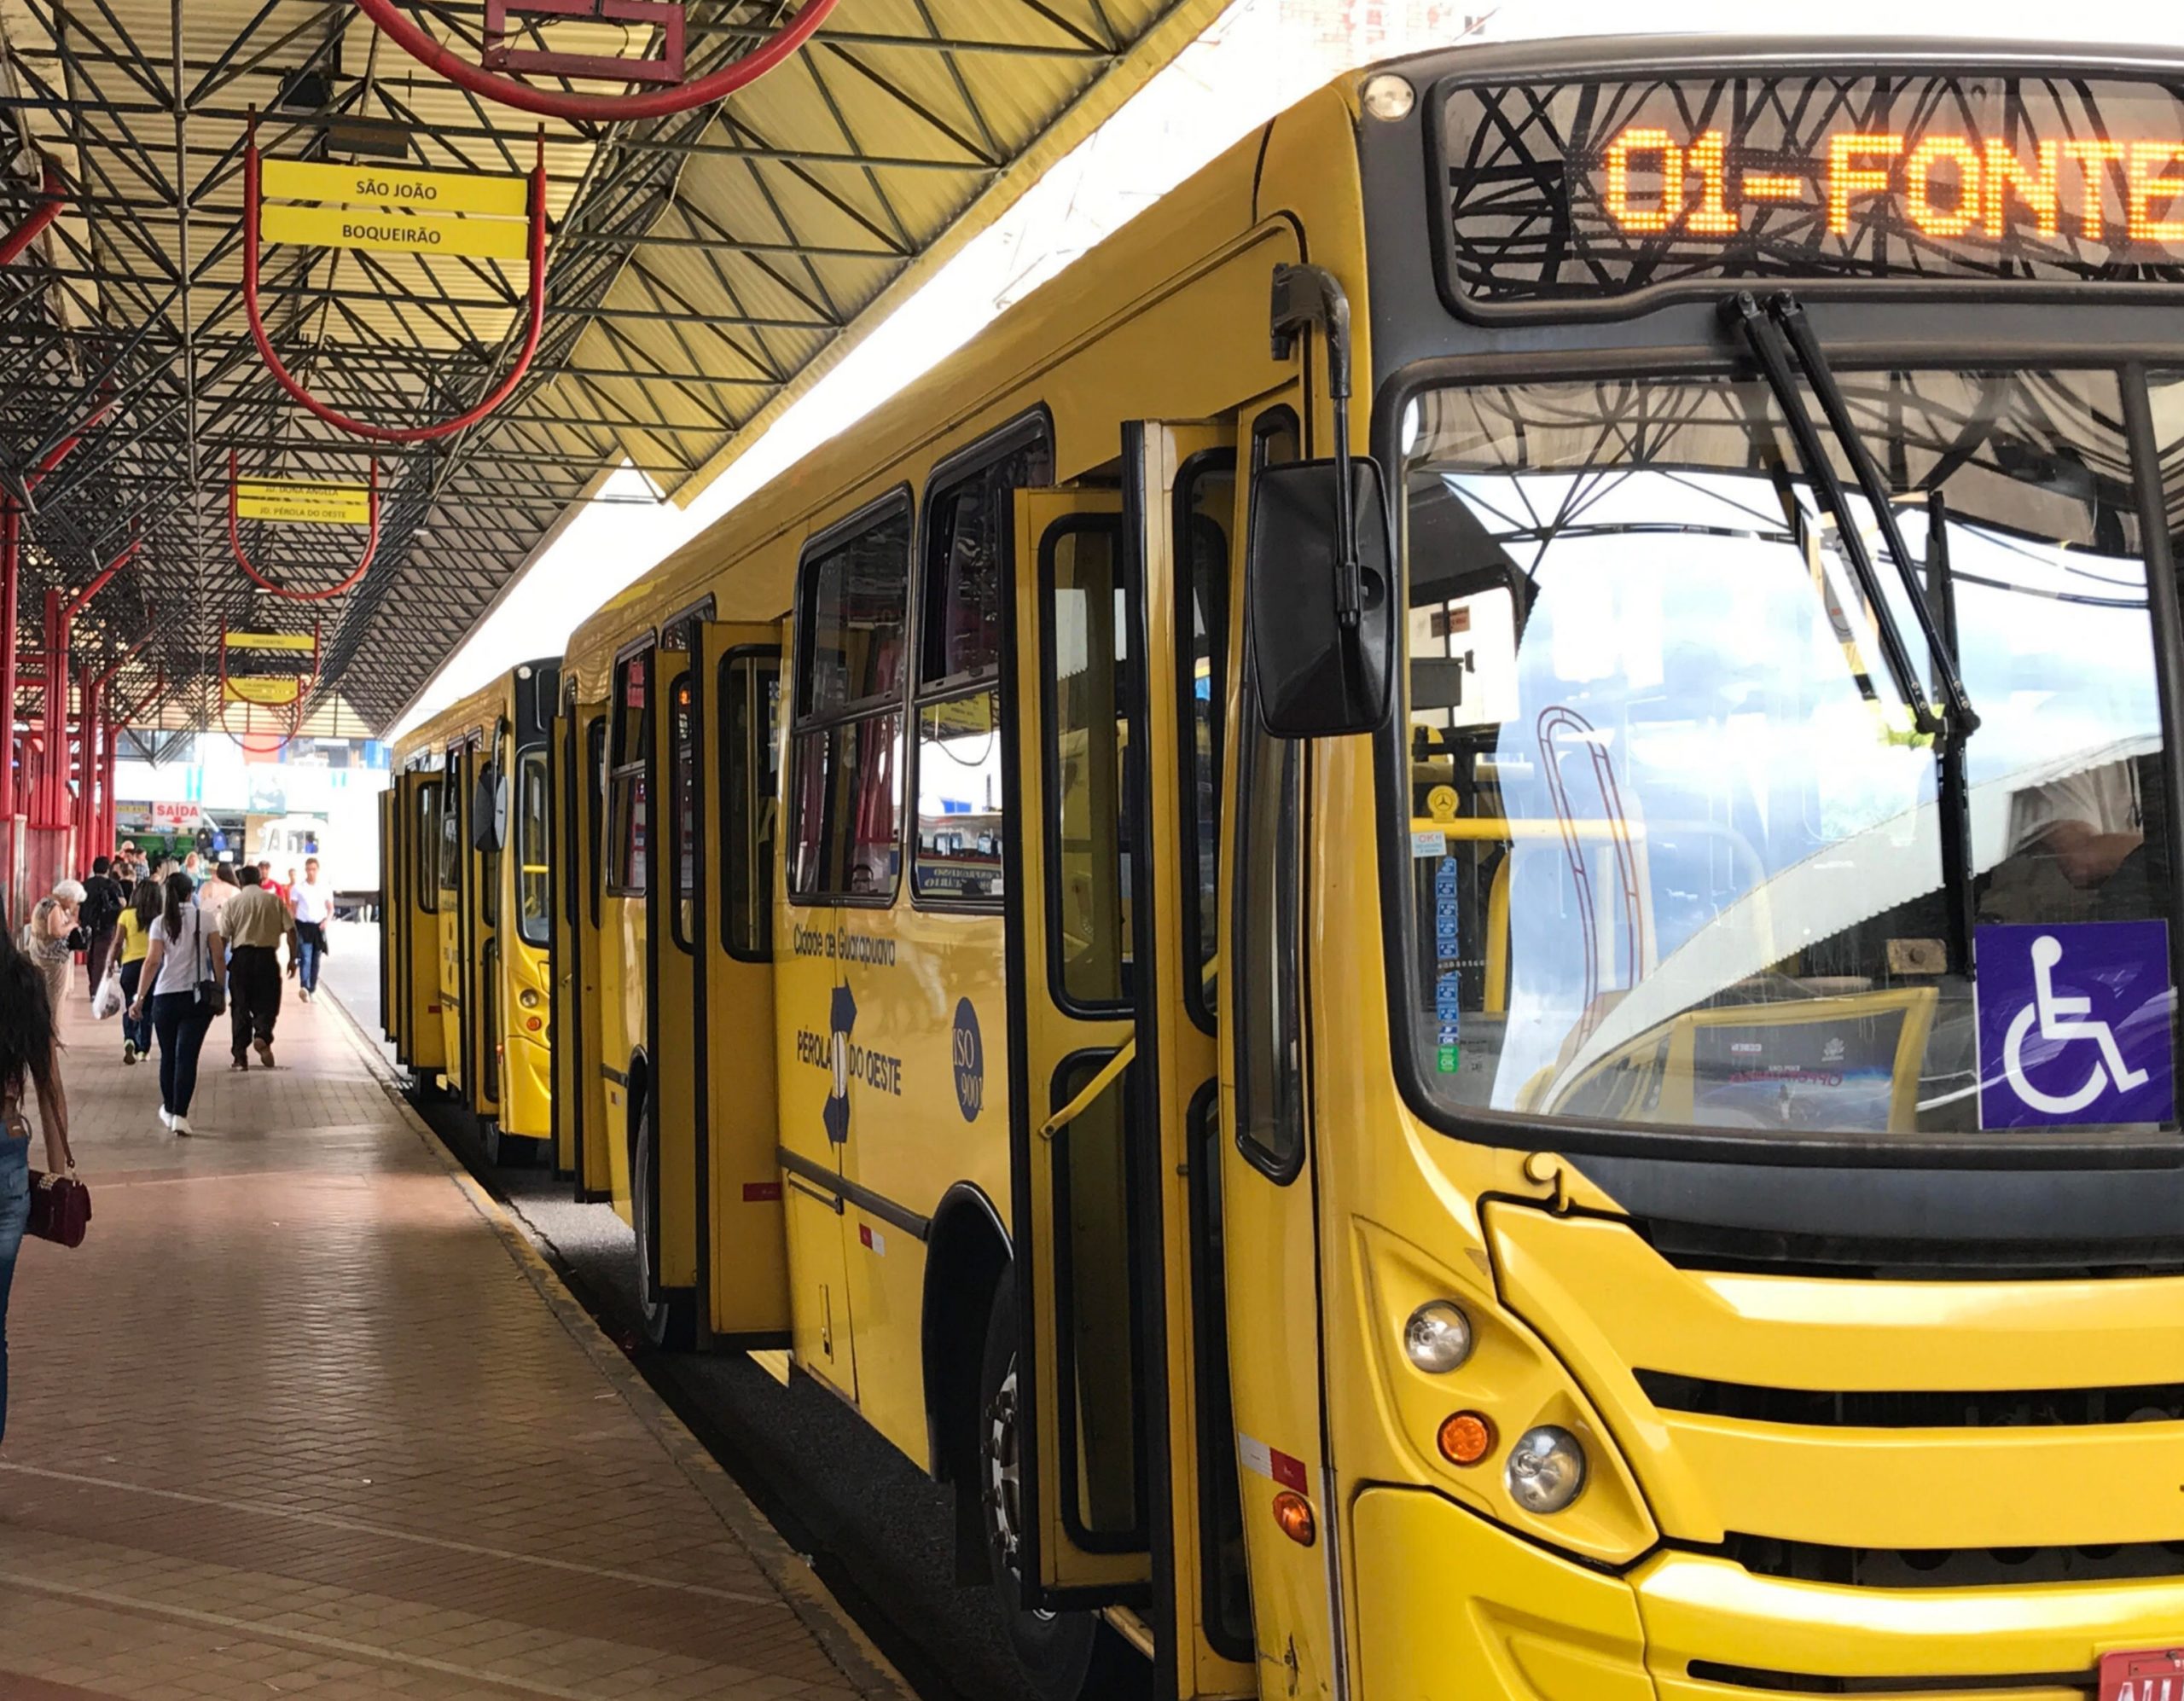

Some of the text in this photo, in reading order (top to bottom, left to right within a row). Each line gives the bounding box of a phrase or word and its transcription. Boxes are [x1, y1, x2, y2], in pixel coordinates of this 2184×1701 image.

[356, 178, 438, 200] SÃO JOÃO
[1827, 133, 2184, 240] FONTE
[342, 224, 441, 245] BOQUEIRÃO
[273, 505, 305, 516] PÉROLA
[306, 508, 321, 517] DO
[322, 509, 346, 519] OESTE
[157, 803, 199, 817] SAÍDA
[793, 923, 896, 971] Cidade de Guarapuava
[797, 1025, 902, 1096] PÉROLA DO OESTE
[953, 1028, 974, 1069] ISO
[961, 1072, 983, 1110] 9001
